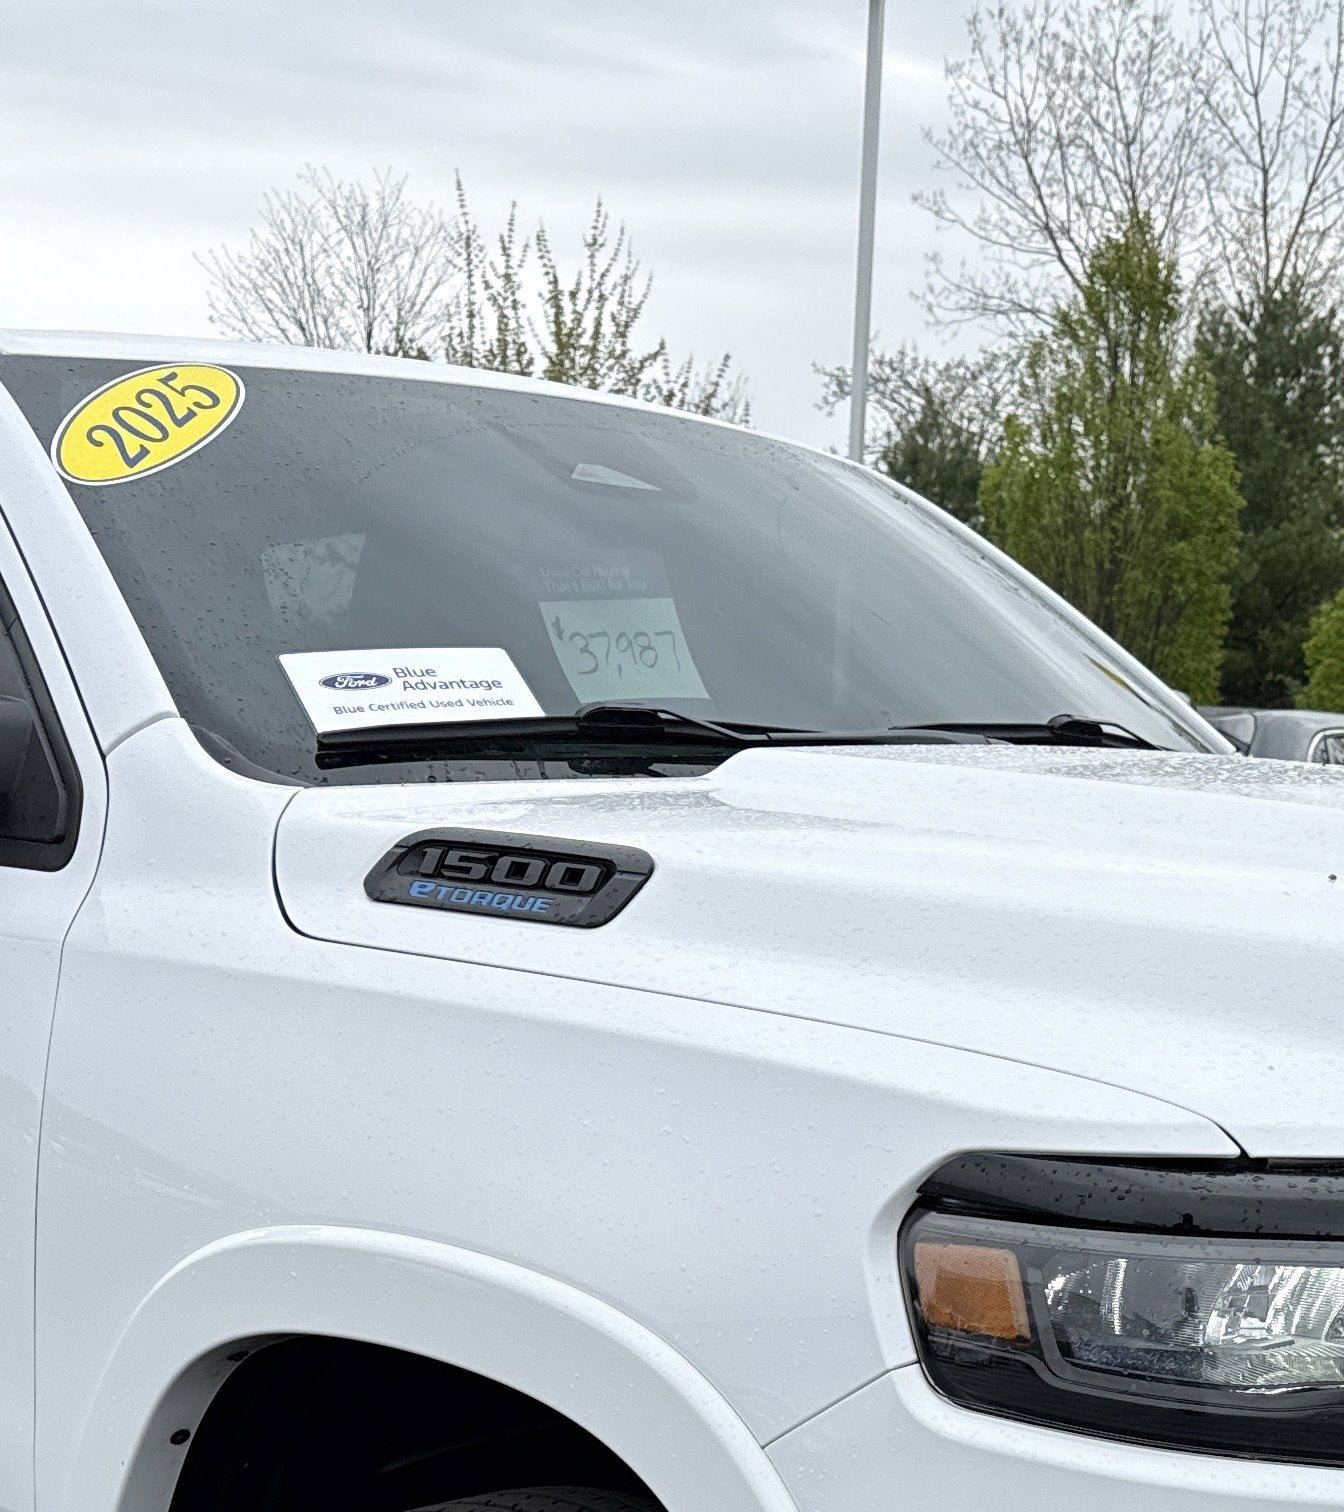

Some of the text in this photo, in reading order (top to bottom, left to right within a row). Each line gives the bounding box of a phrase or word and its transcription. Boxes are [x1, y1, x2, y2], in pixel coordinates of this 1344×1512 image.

[86, 371, 221, 469] 2025
[393, 666, 437, 678] Blue
[402, 678, 503, 691] Advantage
[333, 697, 514, 715] Blue Certified Used Vehicle
[419, 846, 605, 892] 1500
